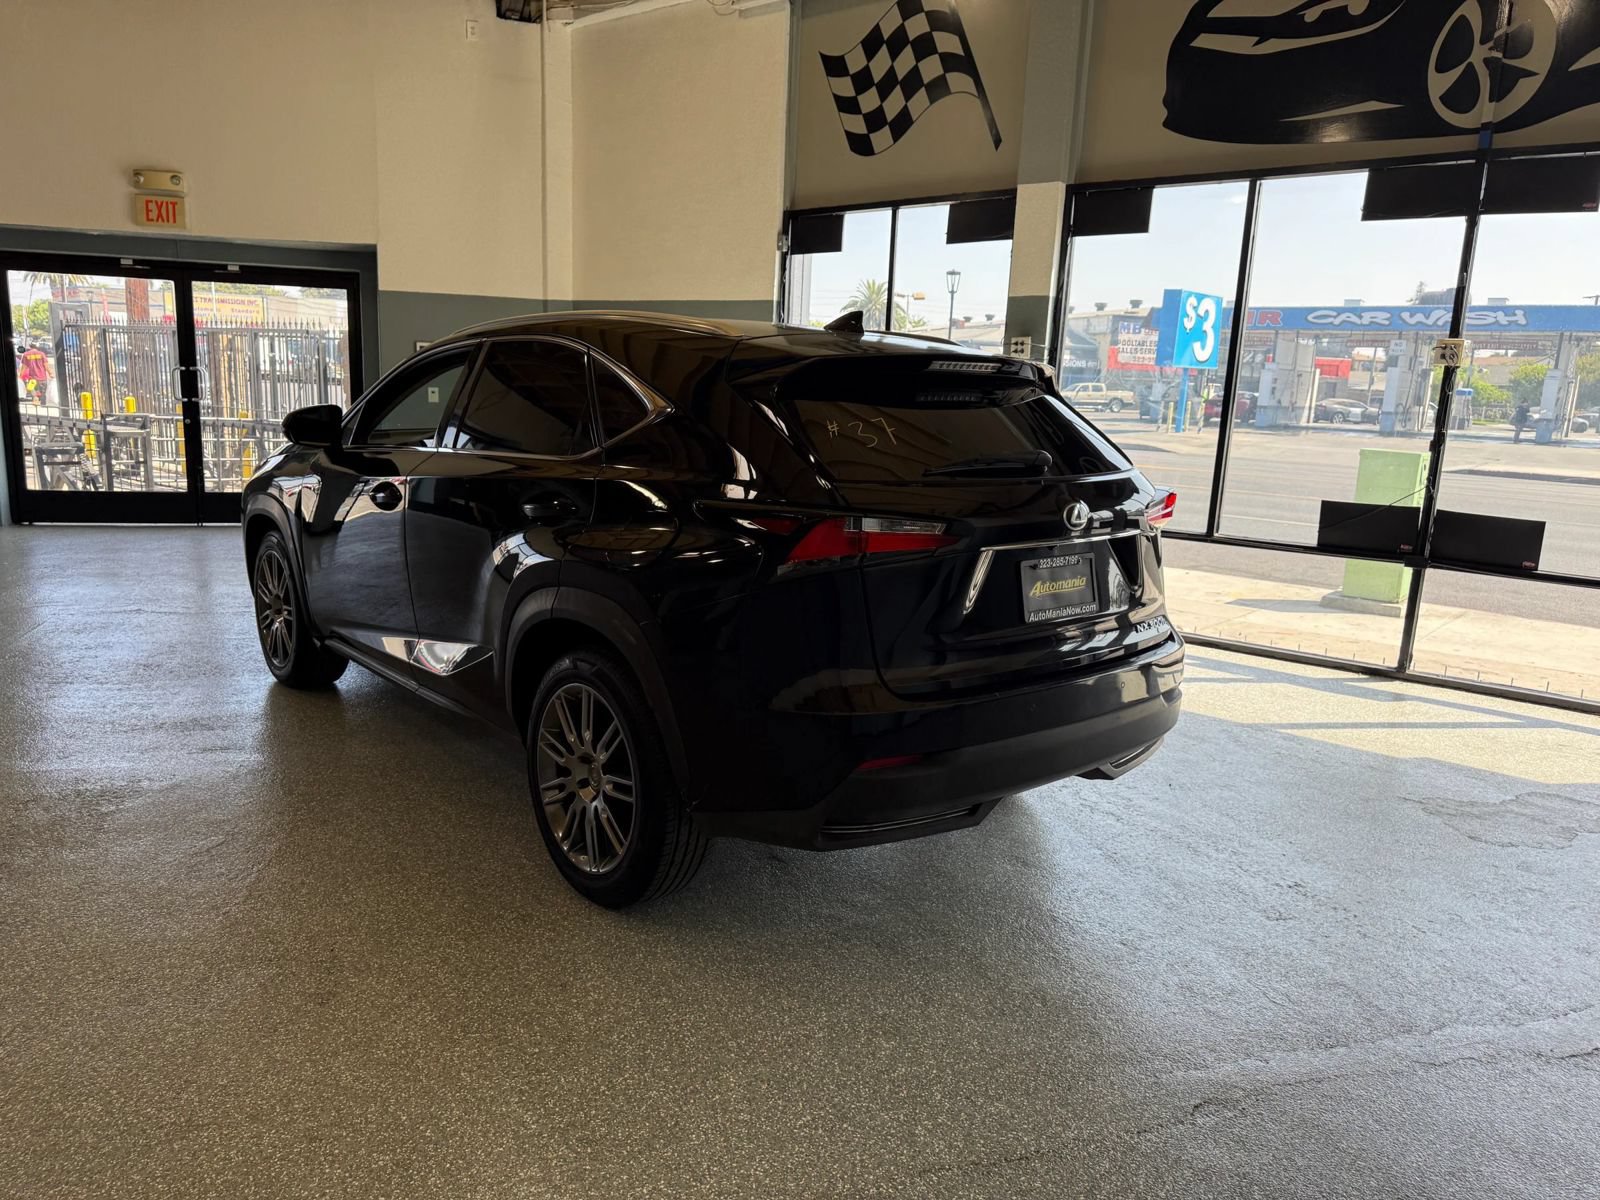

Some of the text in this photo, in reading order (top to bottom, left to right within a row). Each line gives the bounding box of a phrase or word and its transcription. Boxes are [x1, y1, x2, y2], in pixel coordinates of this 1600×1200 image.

[145, 199, 177, 224] EXIT
[1306, 309, 1392, 326] CAR
[1400, 309, 1528, 327] WASH
[1120, 322, 1141, 334] MB
[1184, 295, 1216, 362] $3
[1029, 576, 1087, 597] Automania
[1029, 604, 1097, 622] AutoManiaNow.com
